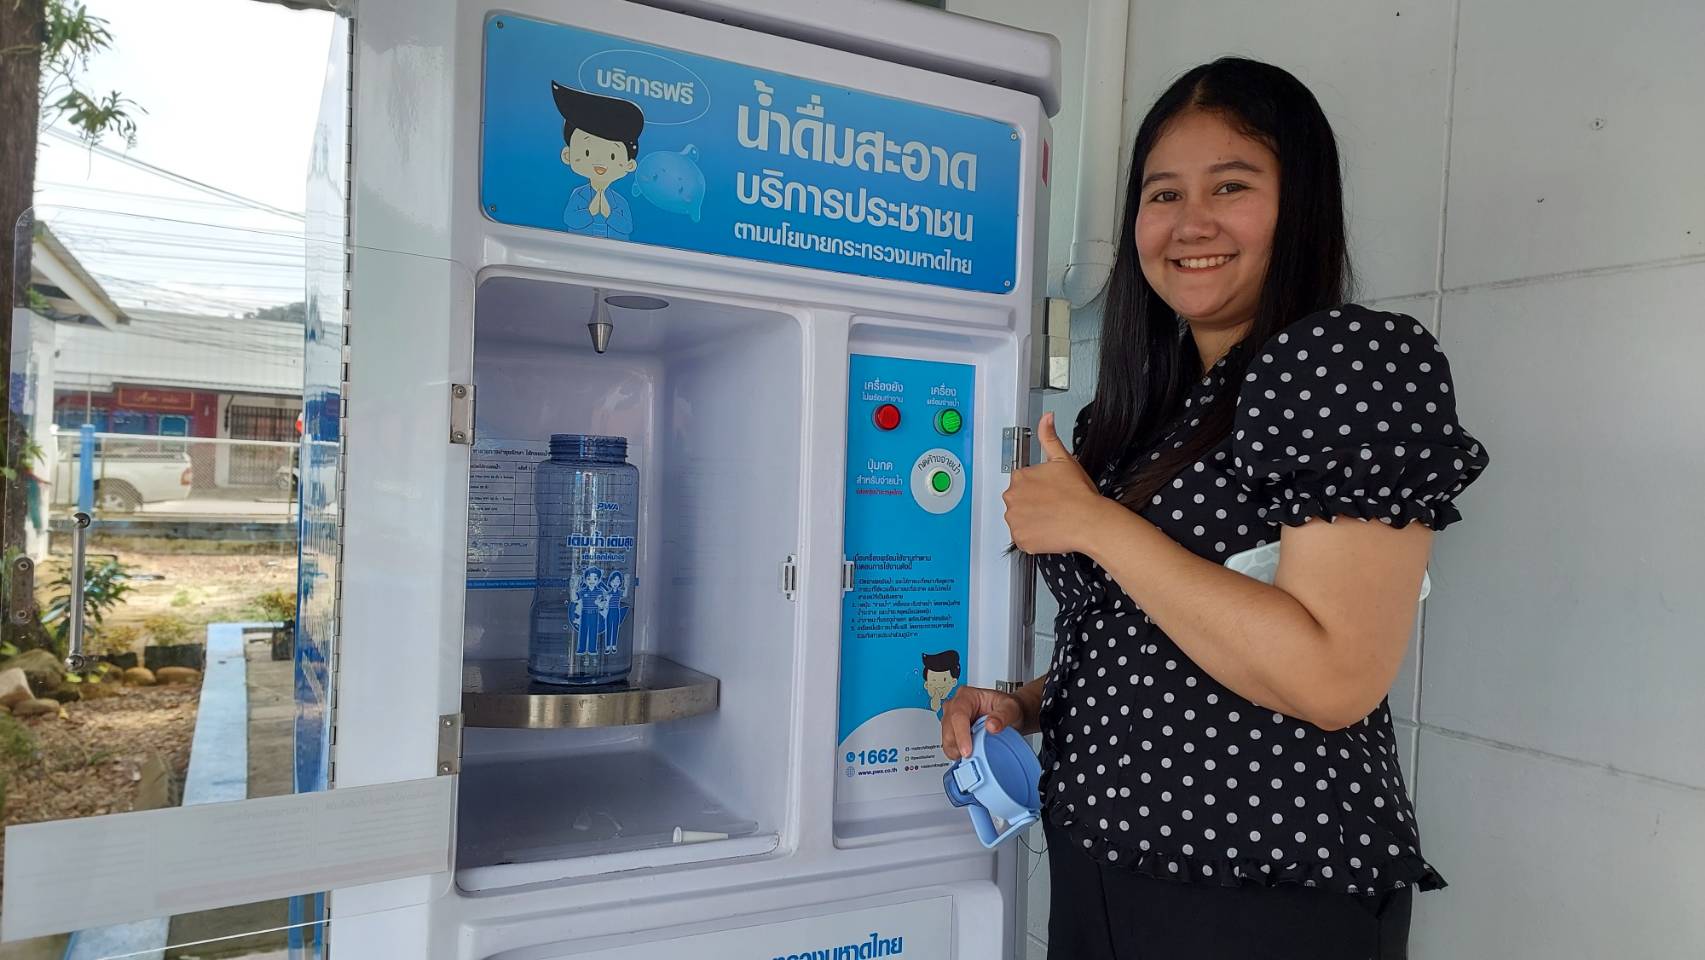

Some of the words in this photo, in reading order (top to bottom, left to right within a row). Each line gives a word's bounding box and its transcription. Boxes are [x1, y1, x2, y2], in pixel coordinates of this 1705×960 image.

[597, 66, 694, 106] บริการฟรี
[737, 79, 978, 192] น้ำดื่มสะอาด
[736, 168, 974, 242] บริการประชาชน
[734, 220, 973, 275] ตามนโยบายกระทรวงมหาดไทย
[931, 383, 957, 397] เครื่อง
[867, 458, 893, 473] ปุ่มกด
[597, 502, 620, 511] PWA
[858, 748, 898, 765] 1662
